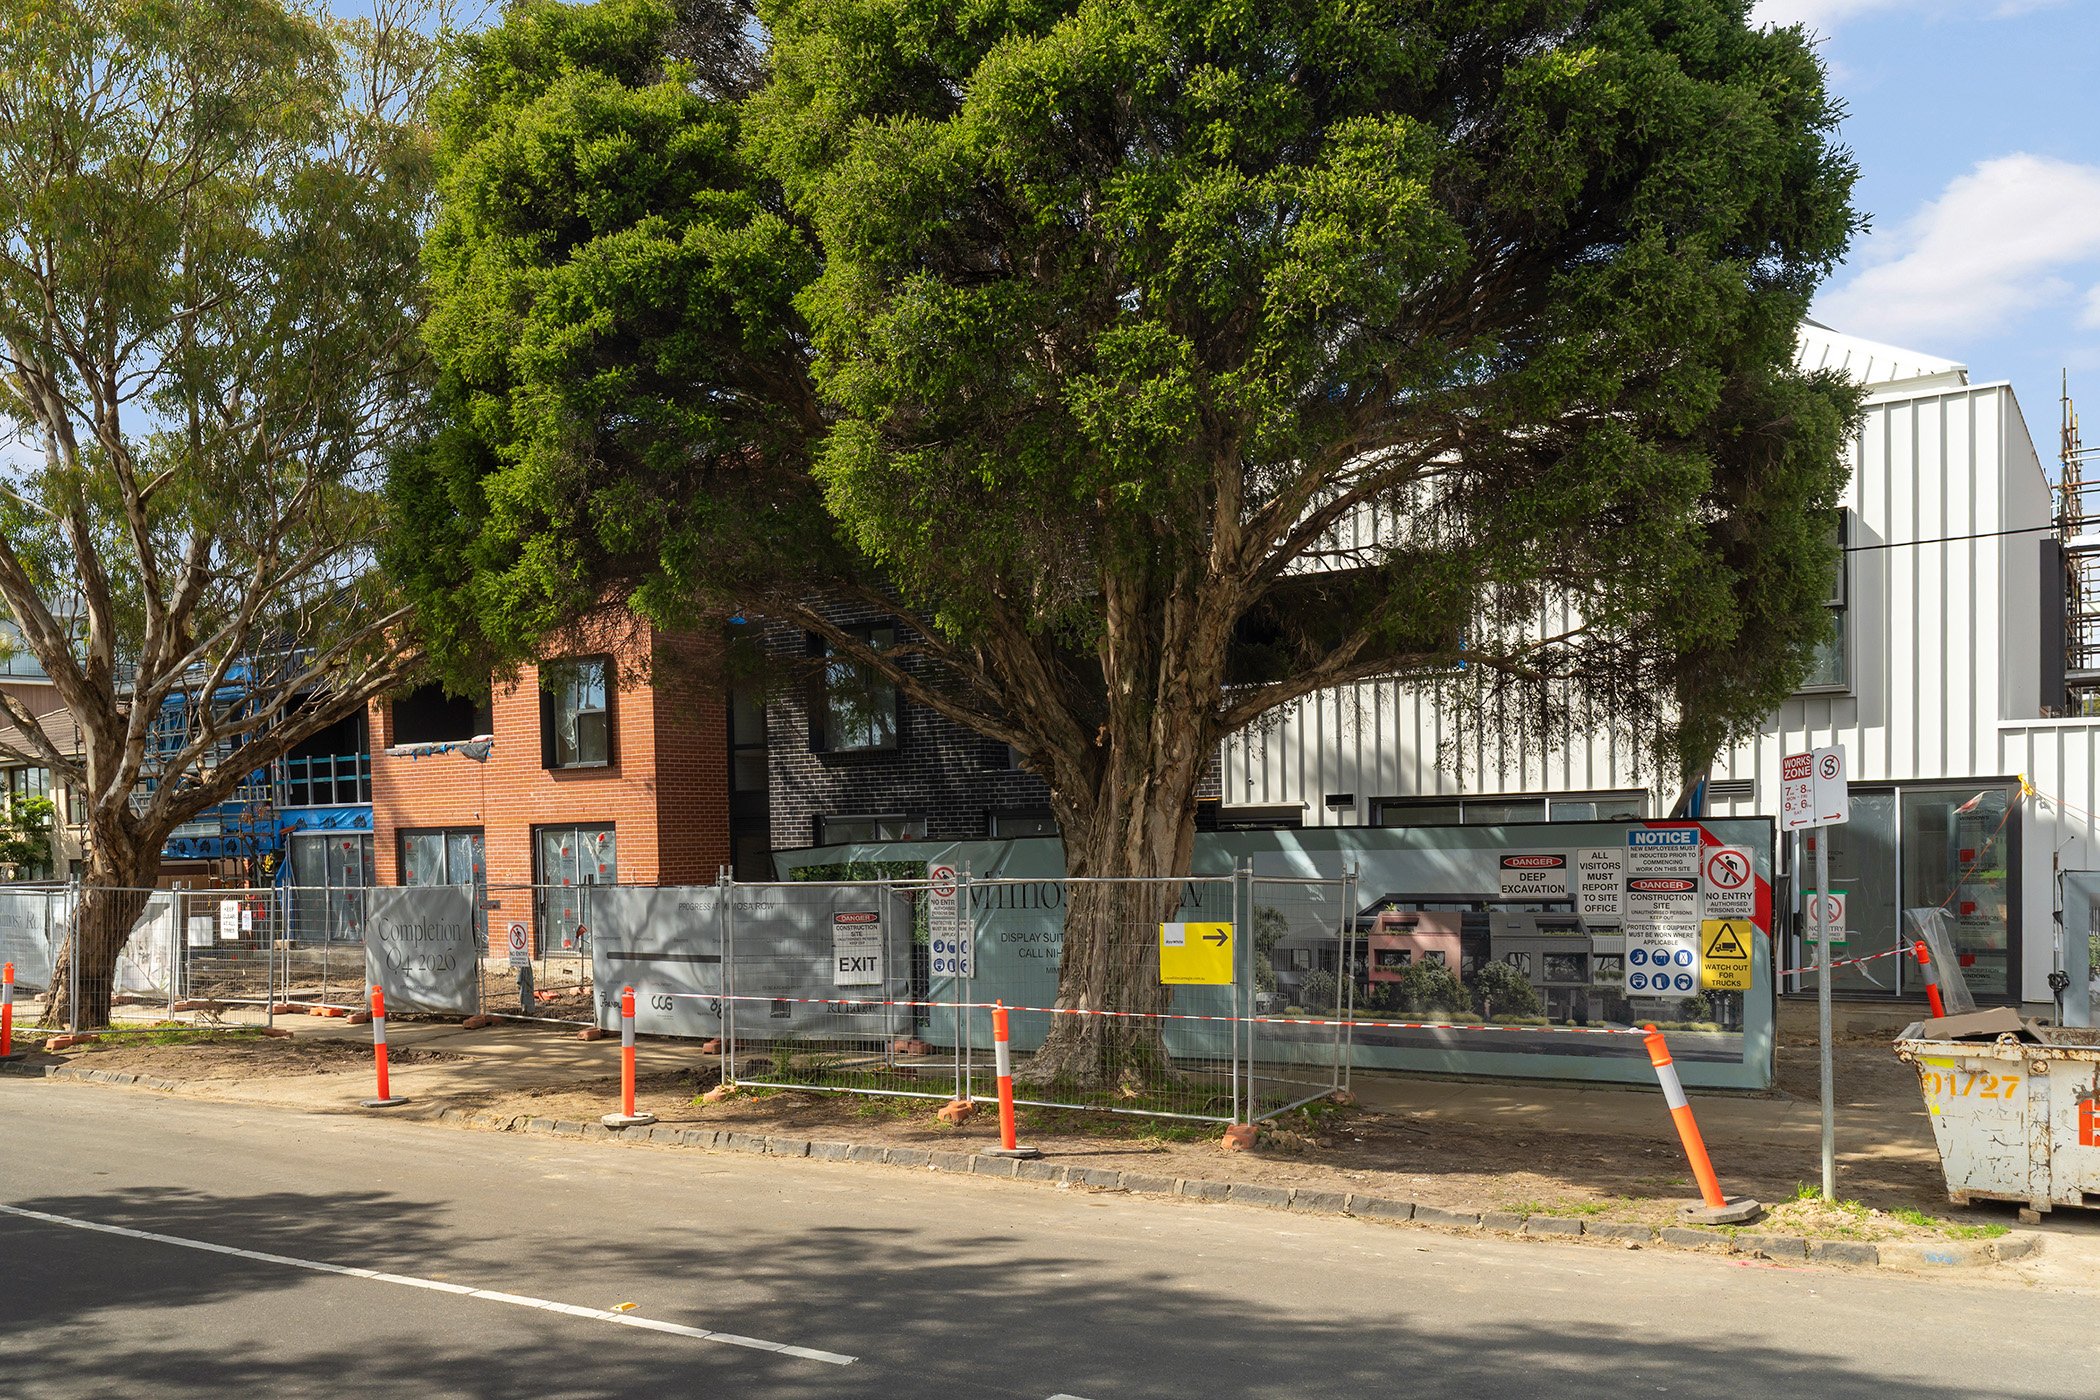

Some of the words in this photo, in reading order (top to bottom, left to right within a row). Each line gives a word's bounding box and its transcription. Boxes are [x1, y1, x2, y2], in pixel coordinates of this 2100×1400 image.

[1784, 755, 1811, 769] WORKS
[1784, 765, 1811, 780] ZONE
[1635, 832, 1691, 844] NOTICE
[1512, 858, 1554, 866] DANGER
[1580, 862, 1621, 870] VISITORS
[1520, 873, 1546, 881] DEEP
[962, 870, 1068, 910] Mimo
[1501, 884, 1565, 894] EXCAVATION
[1640, 881, 1684, 889] DANGER
[1705, 892, 1721, 900] NO
[1722, 892, 1753, 900] ENTRY
[679, 902, 711, 911] PROGRESS
[756, 902, 774, 910] ROW
[1584, 904, 1617, 912] OFFICE
[1653, 902, 1670, 910] SITE
[378, 916, 462, 948] Completion
[1001, 933, 1041, 943] DISPLAY
[1043, 933, 1064, 943] SUIT
[1018, 948, 1044, 958] CALL
[386, 946, 412, 977] Q4
[418, 947, 456, 972] 2026
[840, 956, 878, 972] EXIT
